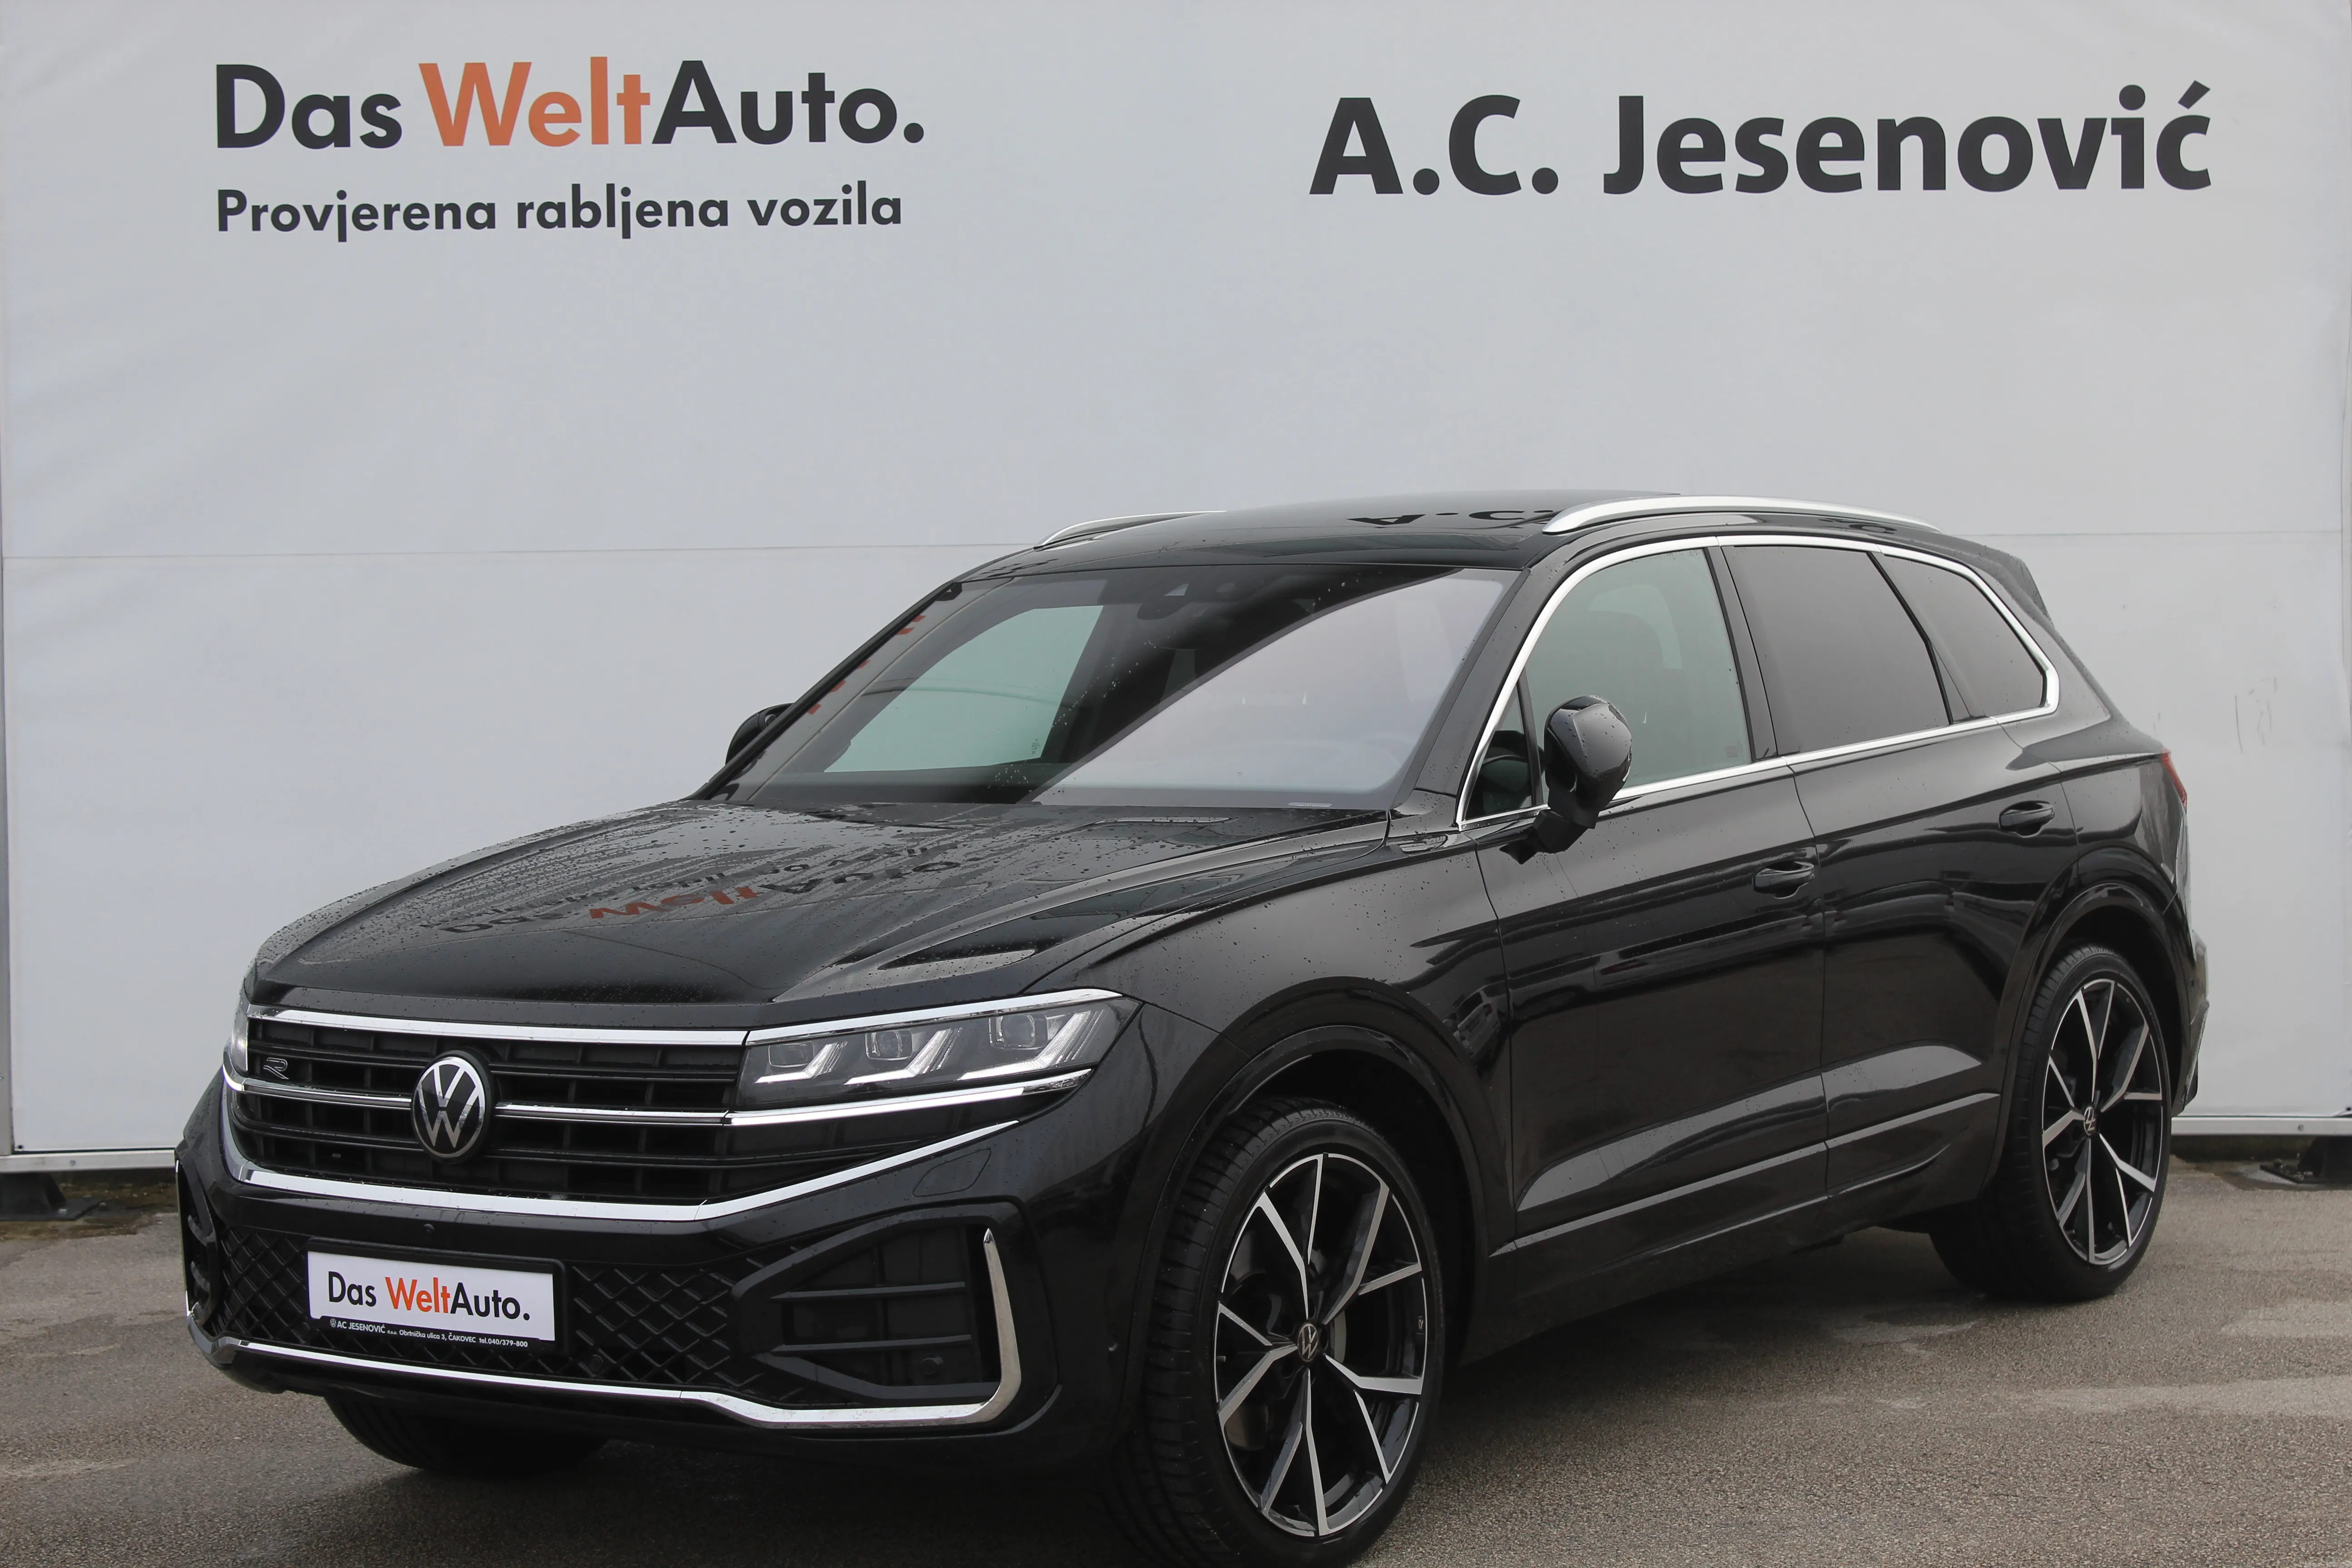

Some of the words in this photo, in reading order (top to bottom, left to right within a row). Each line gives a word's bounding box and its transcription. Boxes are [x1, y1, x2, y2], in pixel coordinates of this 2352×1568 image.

[216, 64, 402, 150] Das
[419, 57, 924, 147] WeltAuto.
[1309, 94, 1558, 196] A.C.
[1603, 80, 2211, 195] Jesenović
[218, 189, 495, 243] Provjerena
[517, 183, 728, 239] rabljena
[747, 180, 901, 226] vozila
[328, 1271, 377, 1307] Das
[385, 1276, 530, 1321] WeltAuto.
[337, 1321, 347, 1329] AC
[348, 1322, 386, 1334] JESENOVIĆ
[399, 1329, 426, 1338] Obrtnička
[448, 1332, 476, 1343] ČAKOVEC
